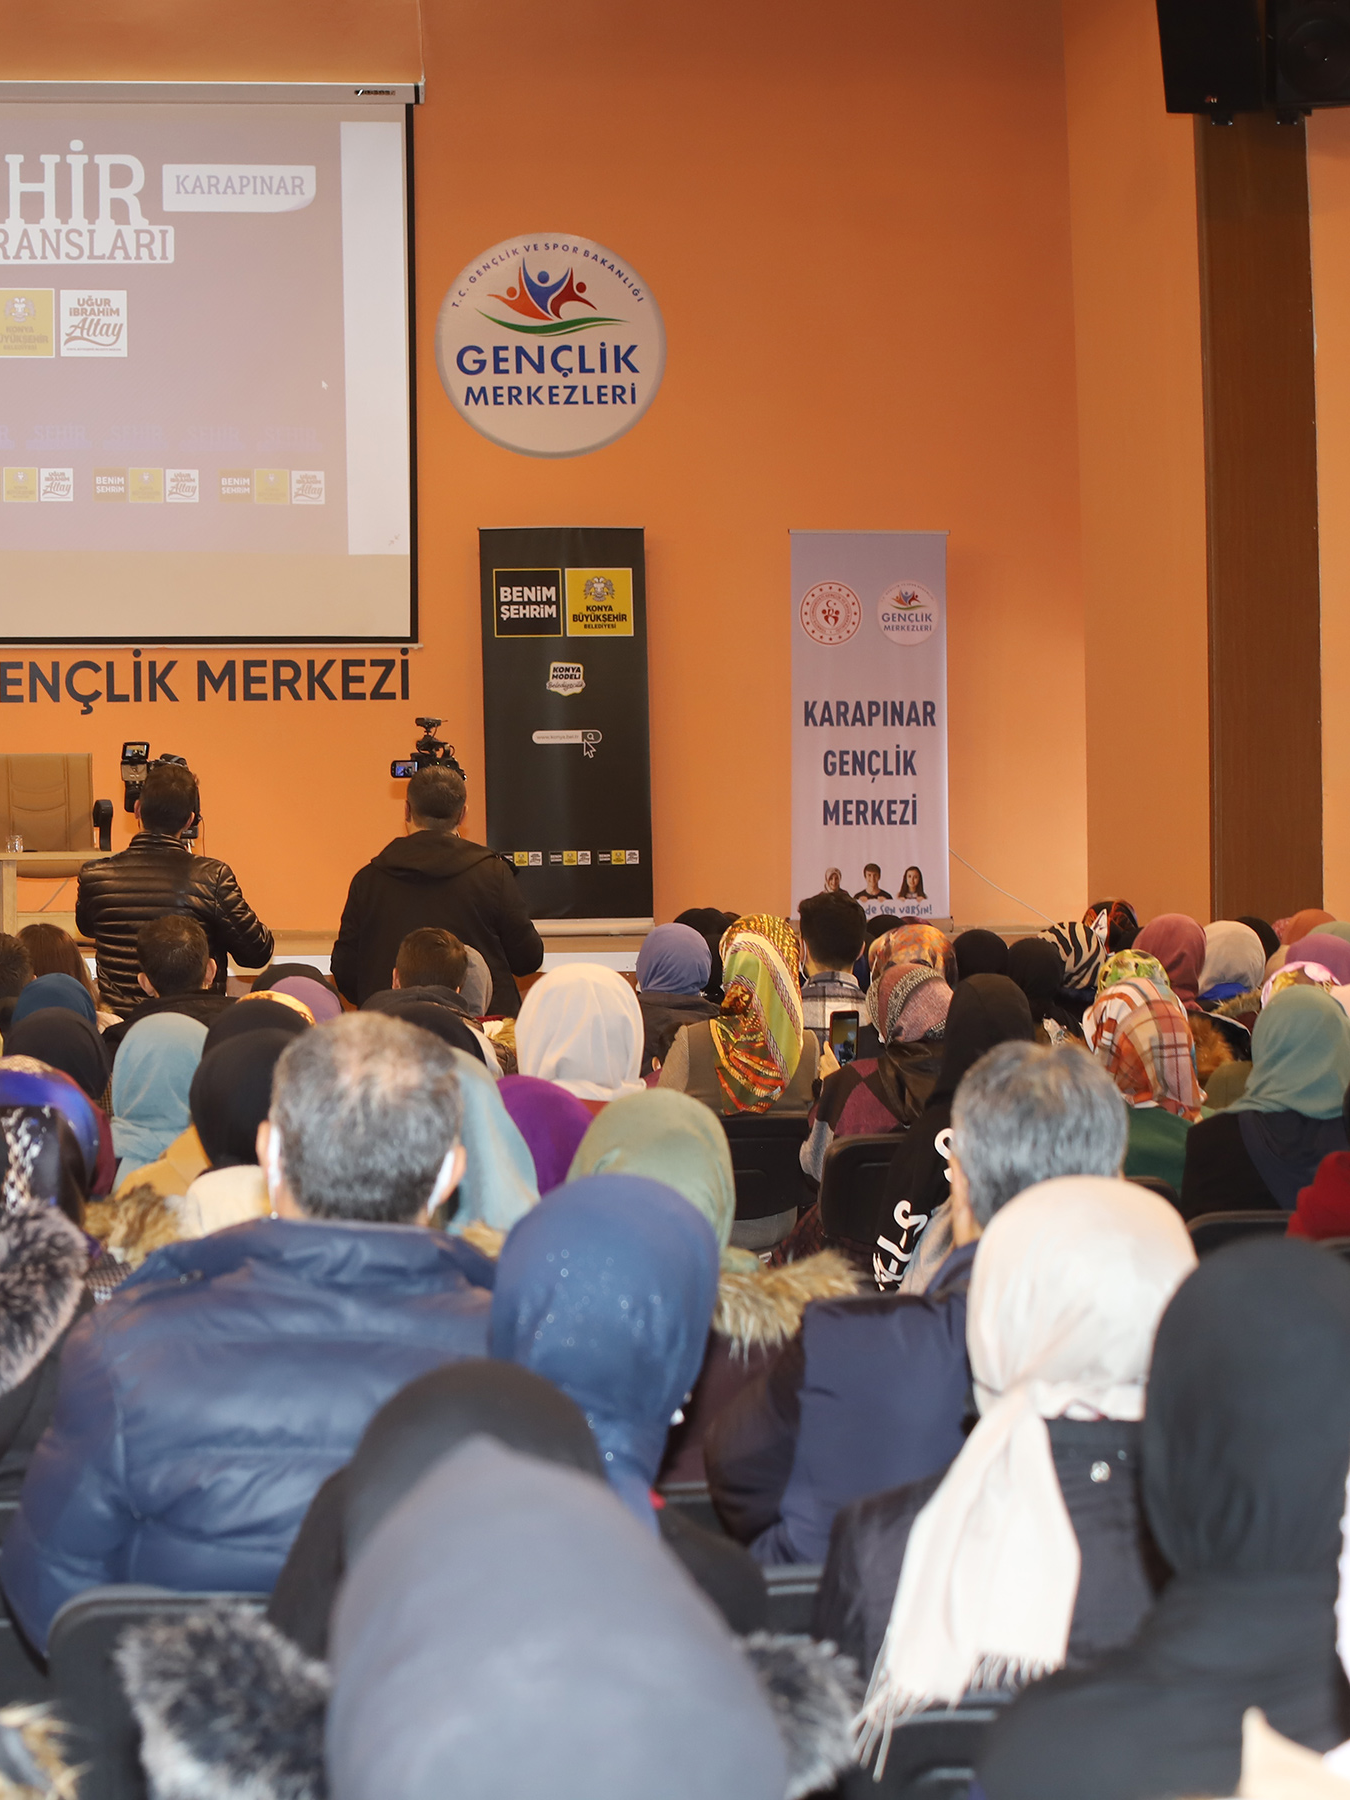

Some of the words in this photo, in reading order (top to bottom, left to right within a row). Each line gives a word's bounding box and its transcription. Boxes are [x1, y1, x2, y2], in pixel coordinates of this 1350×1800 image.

[175, 174, 306, 196] KARAPINAR
[451, 288, 470, 308] T.C.
[468, 248, 520, 284] GENÇLİK
[523, 243, 539, 253] VE
[544, 243, 579, 254] SPOR
[583, 250, 645, 303] BAKANLIĞI
[77, 295, 111, 307] UĞUR
[63, 317, 124, 347] Altay
[456, 342, 640, 378] GENÇLİK
[464, 383, 637, 406] MERKEZLERİ
[572, 612, 627, 623] BÜYÜKŞEHİR
[881, 612, 933, 623] GENÇLİK
[197, 646, 410, 702] MERKEZİ
[804, 700, 937, 727] KARAPINAR
[823, 744, 917, 784] GENÇLİK
[822, 793, 917, 826] MERKEZİ
